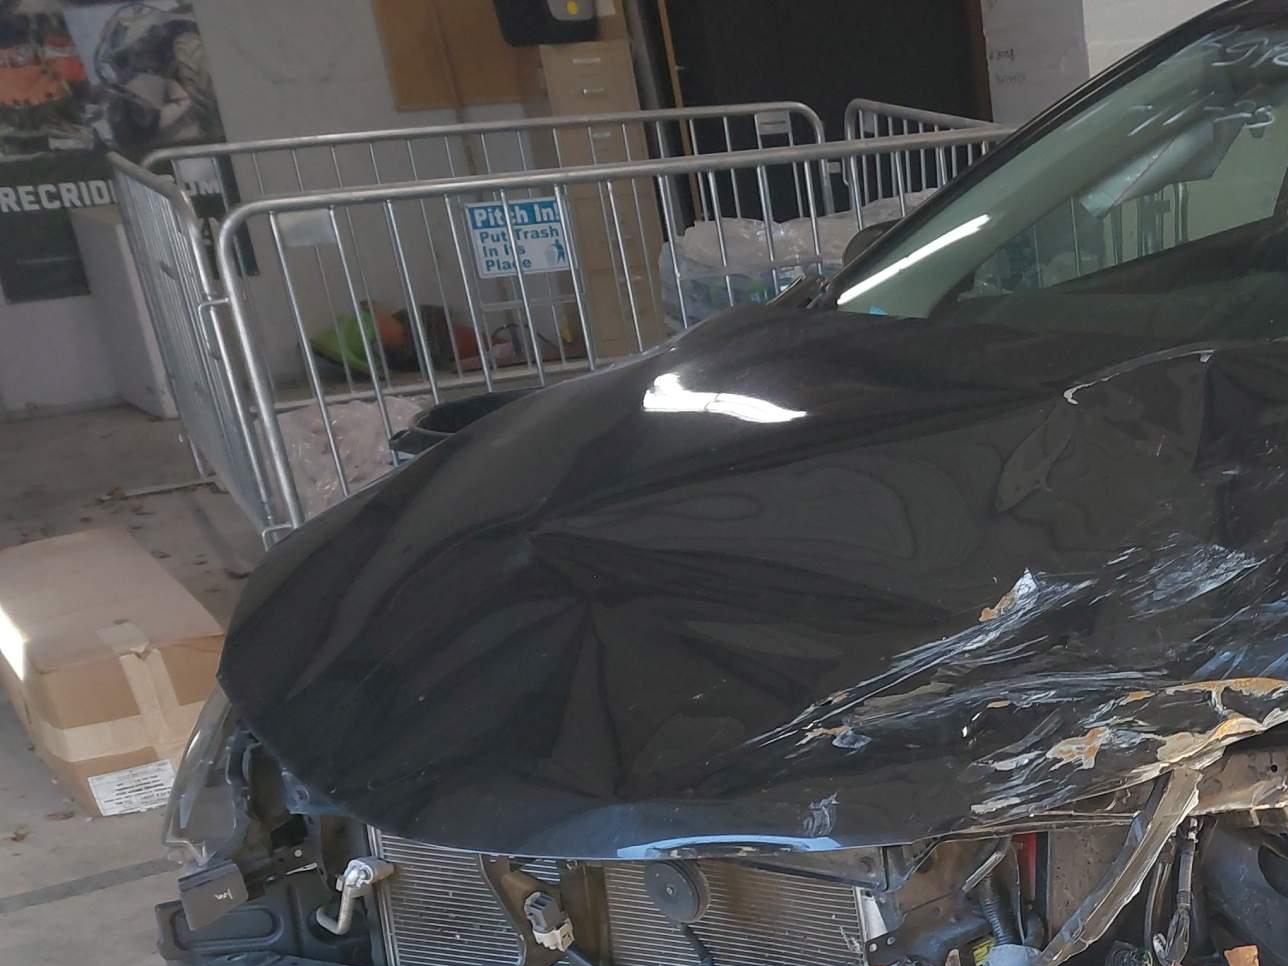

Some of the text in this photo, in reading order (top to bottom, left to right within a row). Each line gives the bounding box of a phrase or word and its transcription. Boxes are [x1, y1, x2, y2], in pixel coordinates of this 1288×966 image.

[479, 226, 559, 243] Put Trash
[482, 244, 526, 257] In Is
